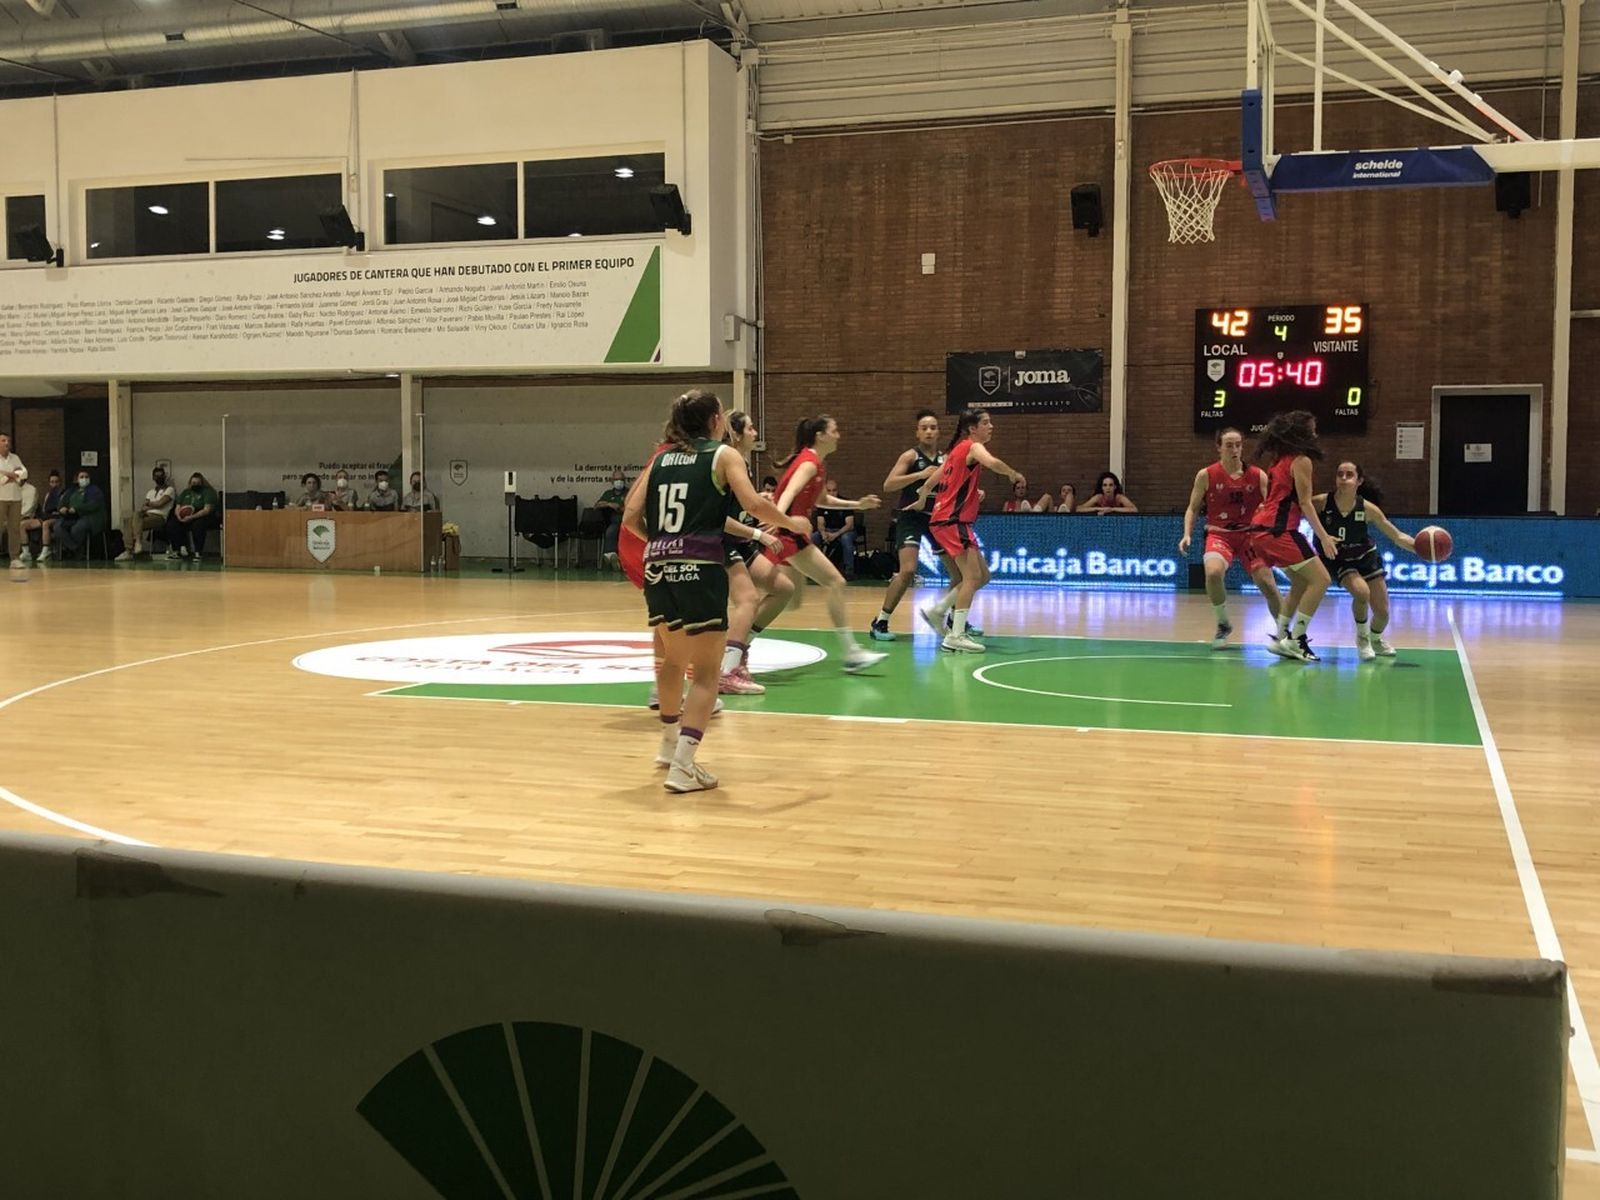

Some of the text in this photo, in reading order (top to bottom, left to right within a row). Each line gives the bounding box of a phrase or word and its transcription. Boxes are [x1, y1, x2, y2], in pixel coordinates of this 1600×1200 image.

[1355, 160, 1403, 170] schelde
[294, 257, 634, 283] JUGADORES DE CANTERA QUE HAN DEBUTADO CON EL PRIMER EQUIPO
[1212, 306, 1362, 336] 42 35
[1274, 325, 1287, 341] 4
[1204, 340, 1358, 356] LOCAL VISITANTE
[1238, 361, 1322, 387] 05:40
[1213, 387, 1361, 408] 3 0
[658, 483, 688, 533] 15
[1338, 527, 1346, 541] 9
[1087, 551, 1176, 575] Banco
[1385, 552, 1564, 588] icaja Banco
